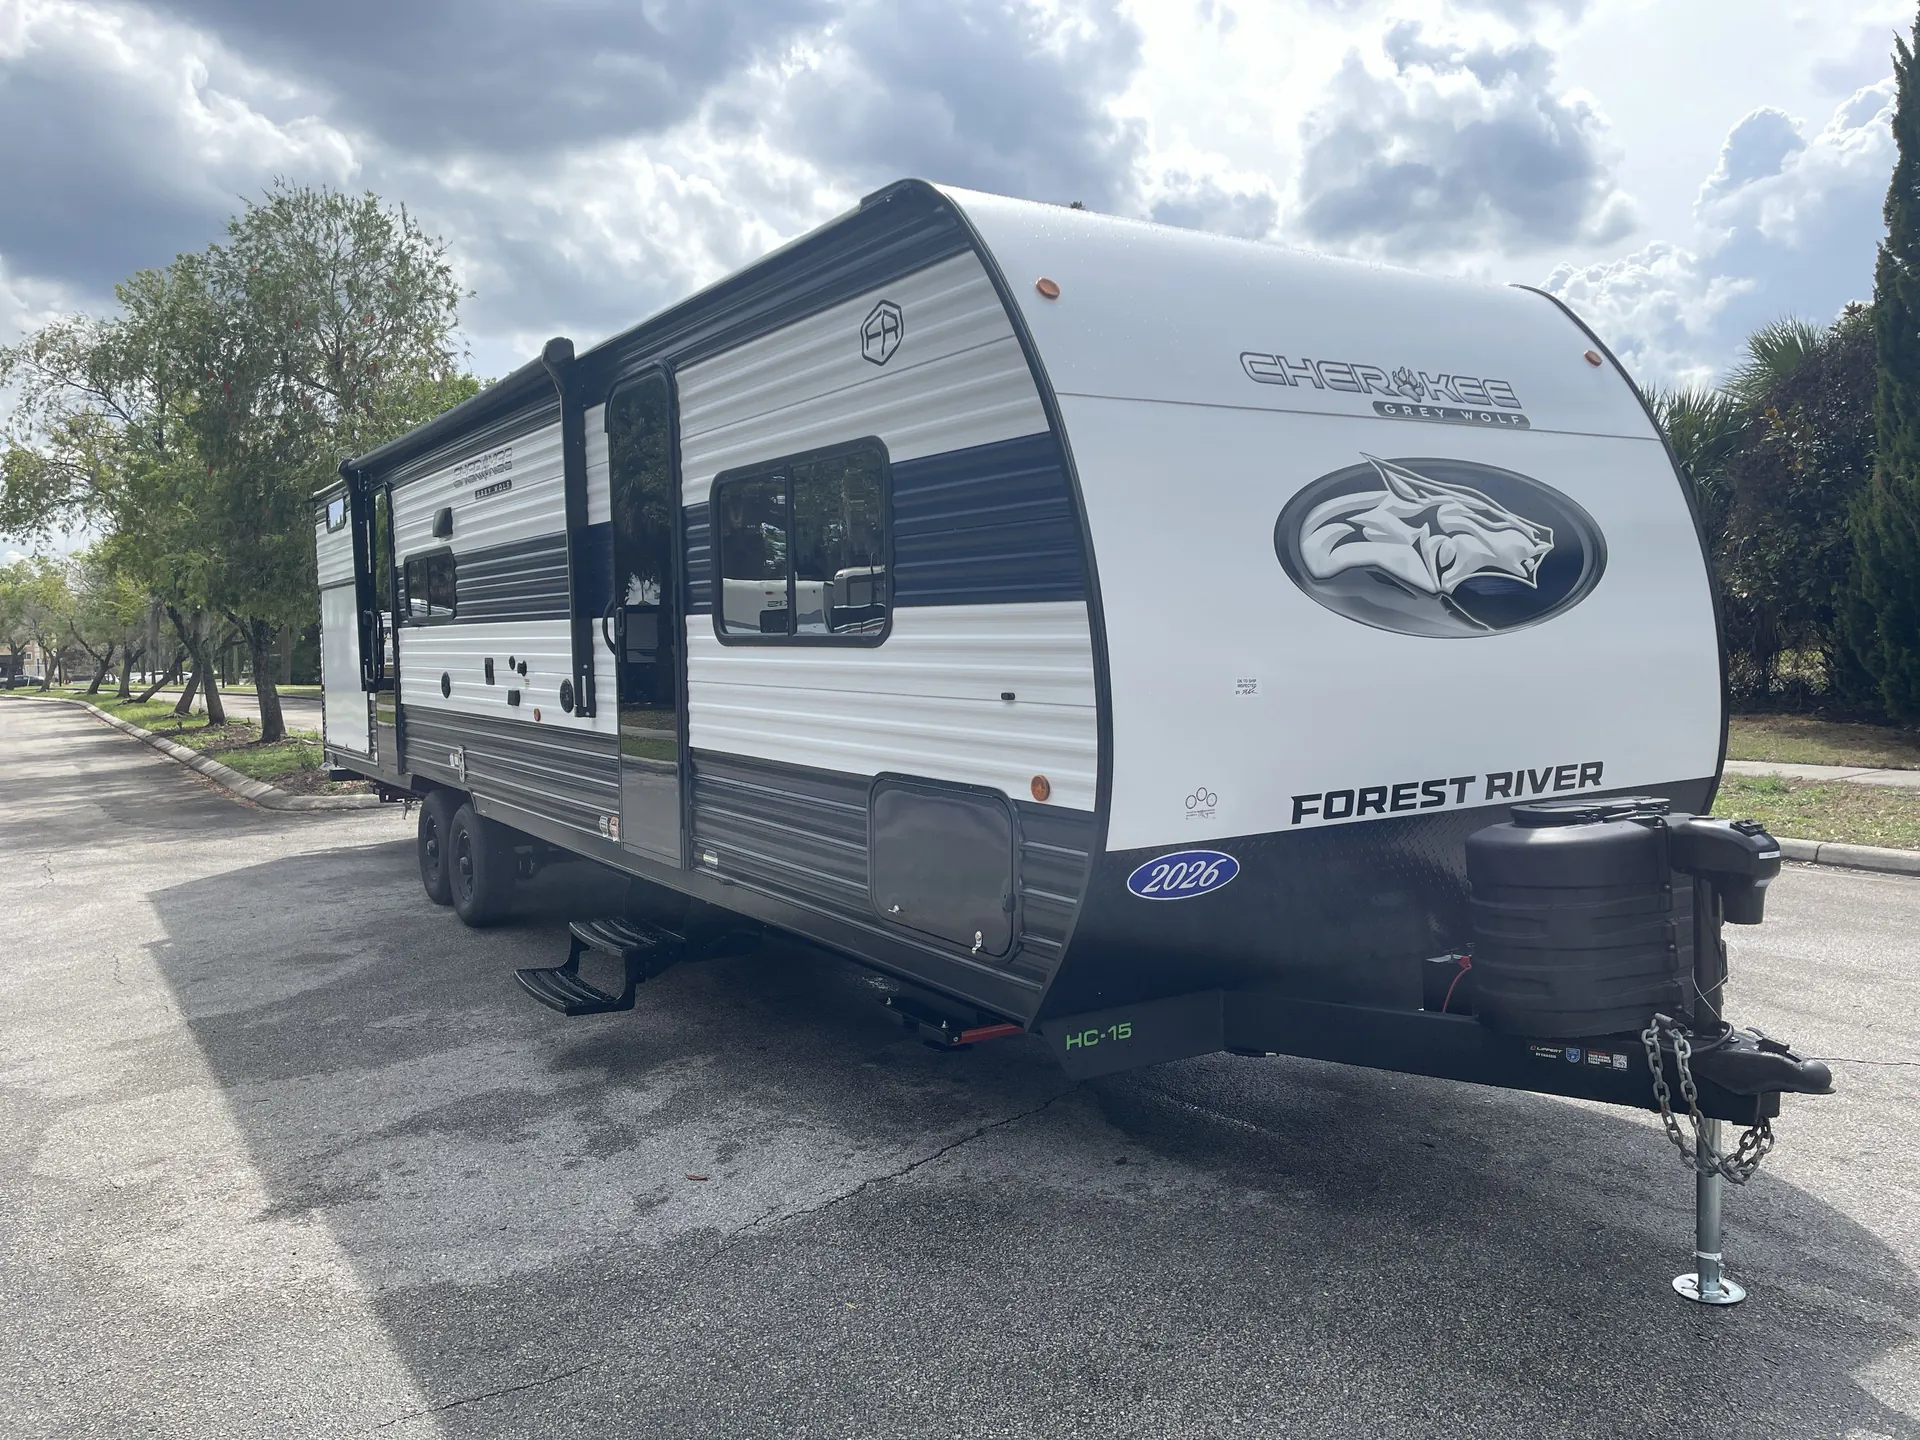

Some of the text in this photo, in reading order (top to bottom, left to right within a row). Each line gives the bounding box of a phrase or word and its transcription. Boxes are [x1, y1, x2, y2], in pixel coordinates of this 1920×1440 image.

[1383, 403, 1521, 425] GREY WOLF
[1290, 761, 1604, 825] FOREST RIVER
[1141, 858, 1227, 893] 2026
[1066, 1022, 1132, 1050] HC-15
